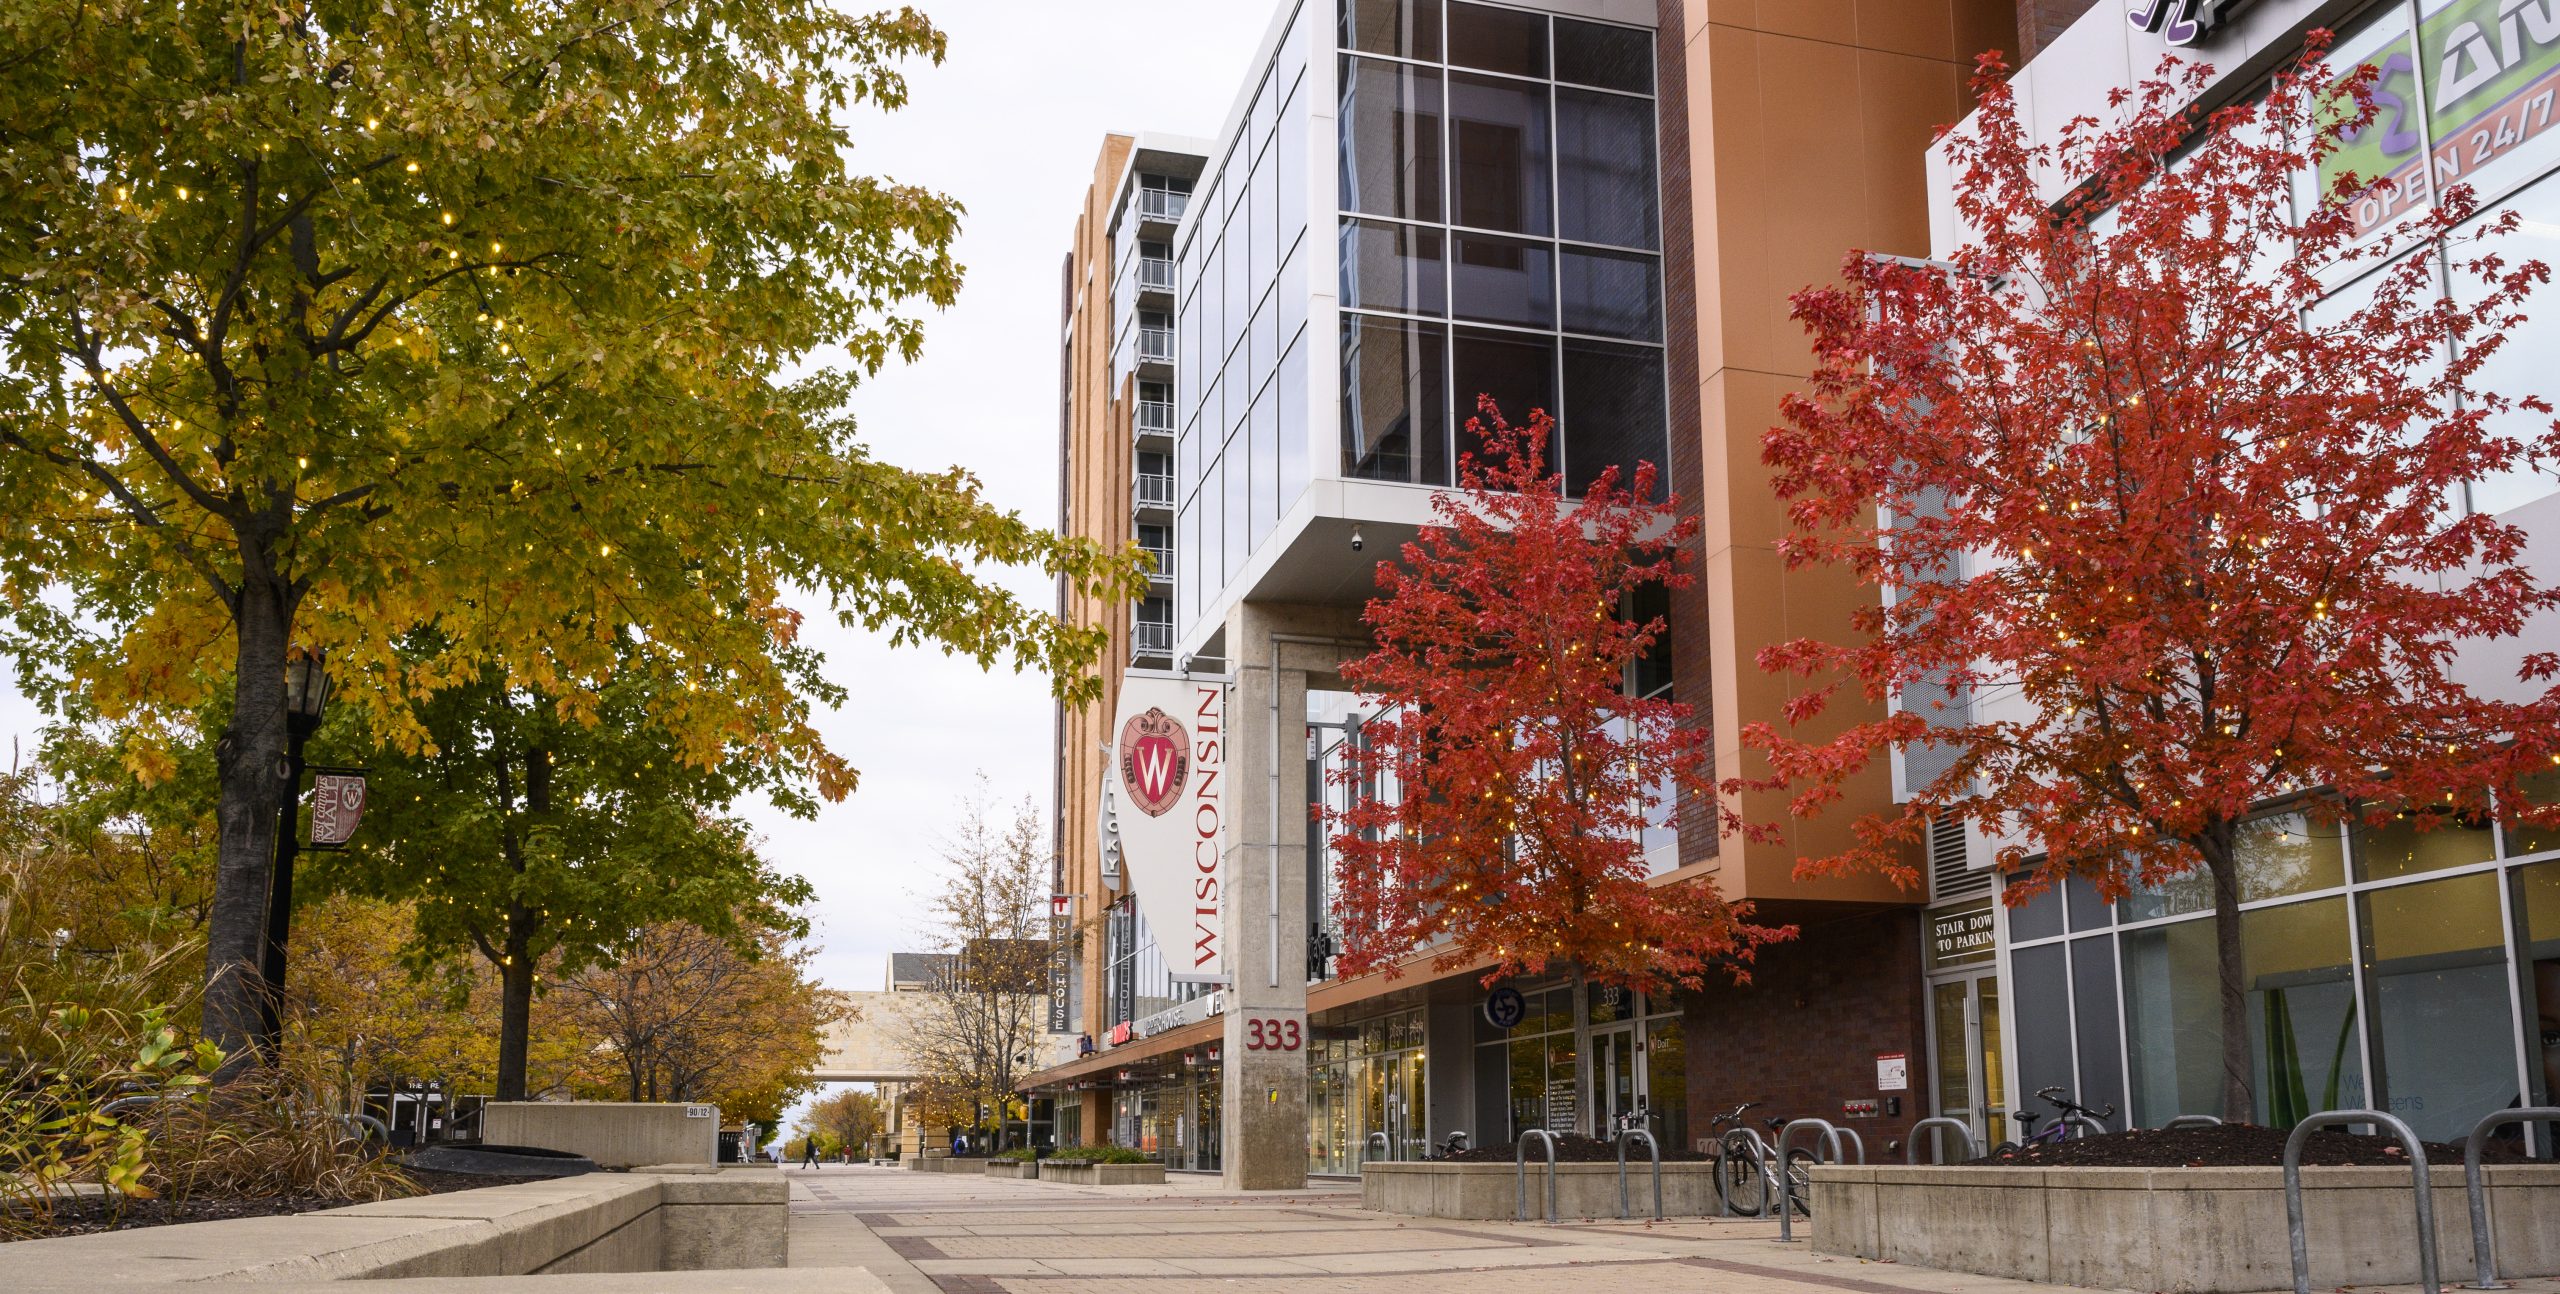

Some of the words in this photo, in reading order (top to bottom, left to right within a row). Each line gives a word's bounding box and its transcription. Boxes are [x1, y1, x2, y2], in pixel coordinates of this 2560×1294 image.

[2358, 146, 2461, 228] OPEN
[2471, 88, 2555, 165] 24/7
[316, 776, 329, 818] campus
[321, 777, 340, 842] MALL
[1195, 687, 1219, 970] WISCONSIN
[1936, 920, 1965, 937] STAIR
[1970, 914, 1993, 930] DOW
[1938, 938, 1952, 952] TO
[1956, 930, 1995, 949] PARKIN
[1055, 977, 1067, 1030] HOUSE
[1601, 986, 1620, 1007] 333
[1246, 1018, 1302, 1052] 333
